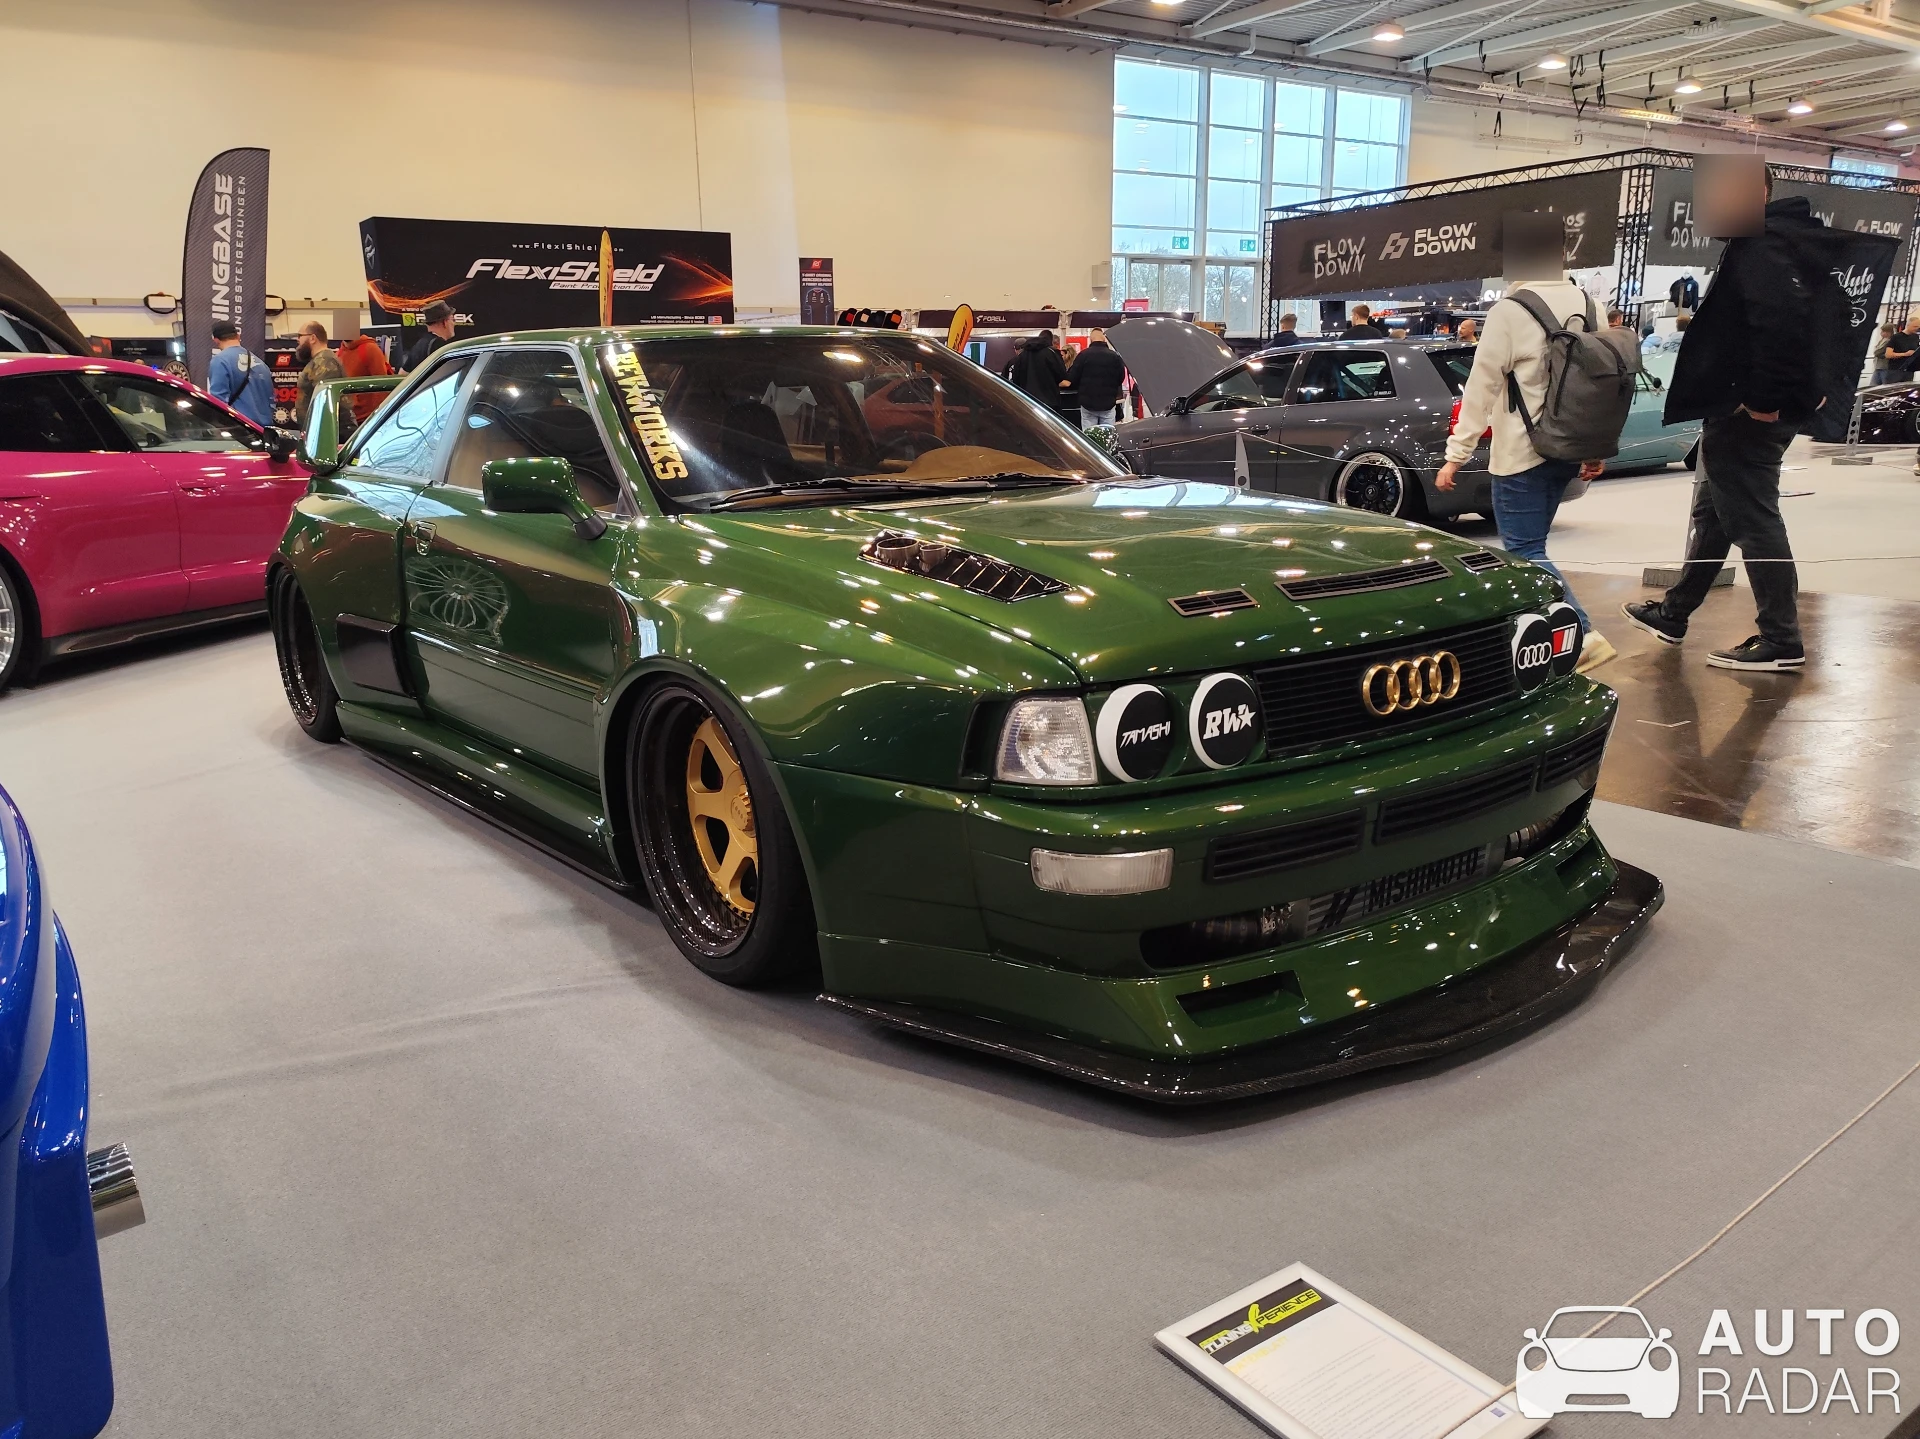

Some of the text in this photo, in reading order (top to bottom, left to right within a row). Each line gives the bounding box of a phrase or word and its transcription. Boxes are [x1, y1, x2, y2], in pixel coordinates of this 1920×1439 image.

[1673, 200, 1694, 225] FL
[1414, 222, 1474, 243] FLOW
[1870, 220, 1902, 235] FLOW
[211, 172, 233, 322] INGBASE
[234, 175, 246, 341] UNGSSTEIGERUNGEN
[512, 242, 624, 252] www.FlexiShielom
[1314, 236, 1366, 261] FLOW
[1413, 236, 1477, 257] DOWN
[465, 258, 666, 283] FlexiSheld
[1314, 253, 1366, 279] DOWN
[580, 282, 632, 290] Protion
[1119, 721, 1171, 749] TAMASHI
